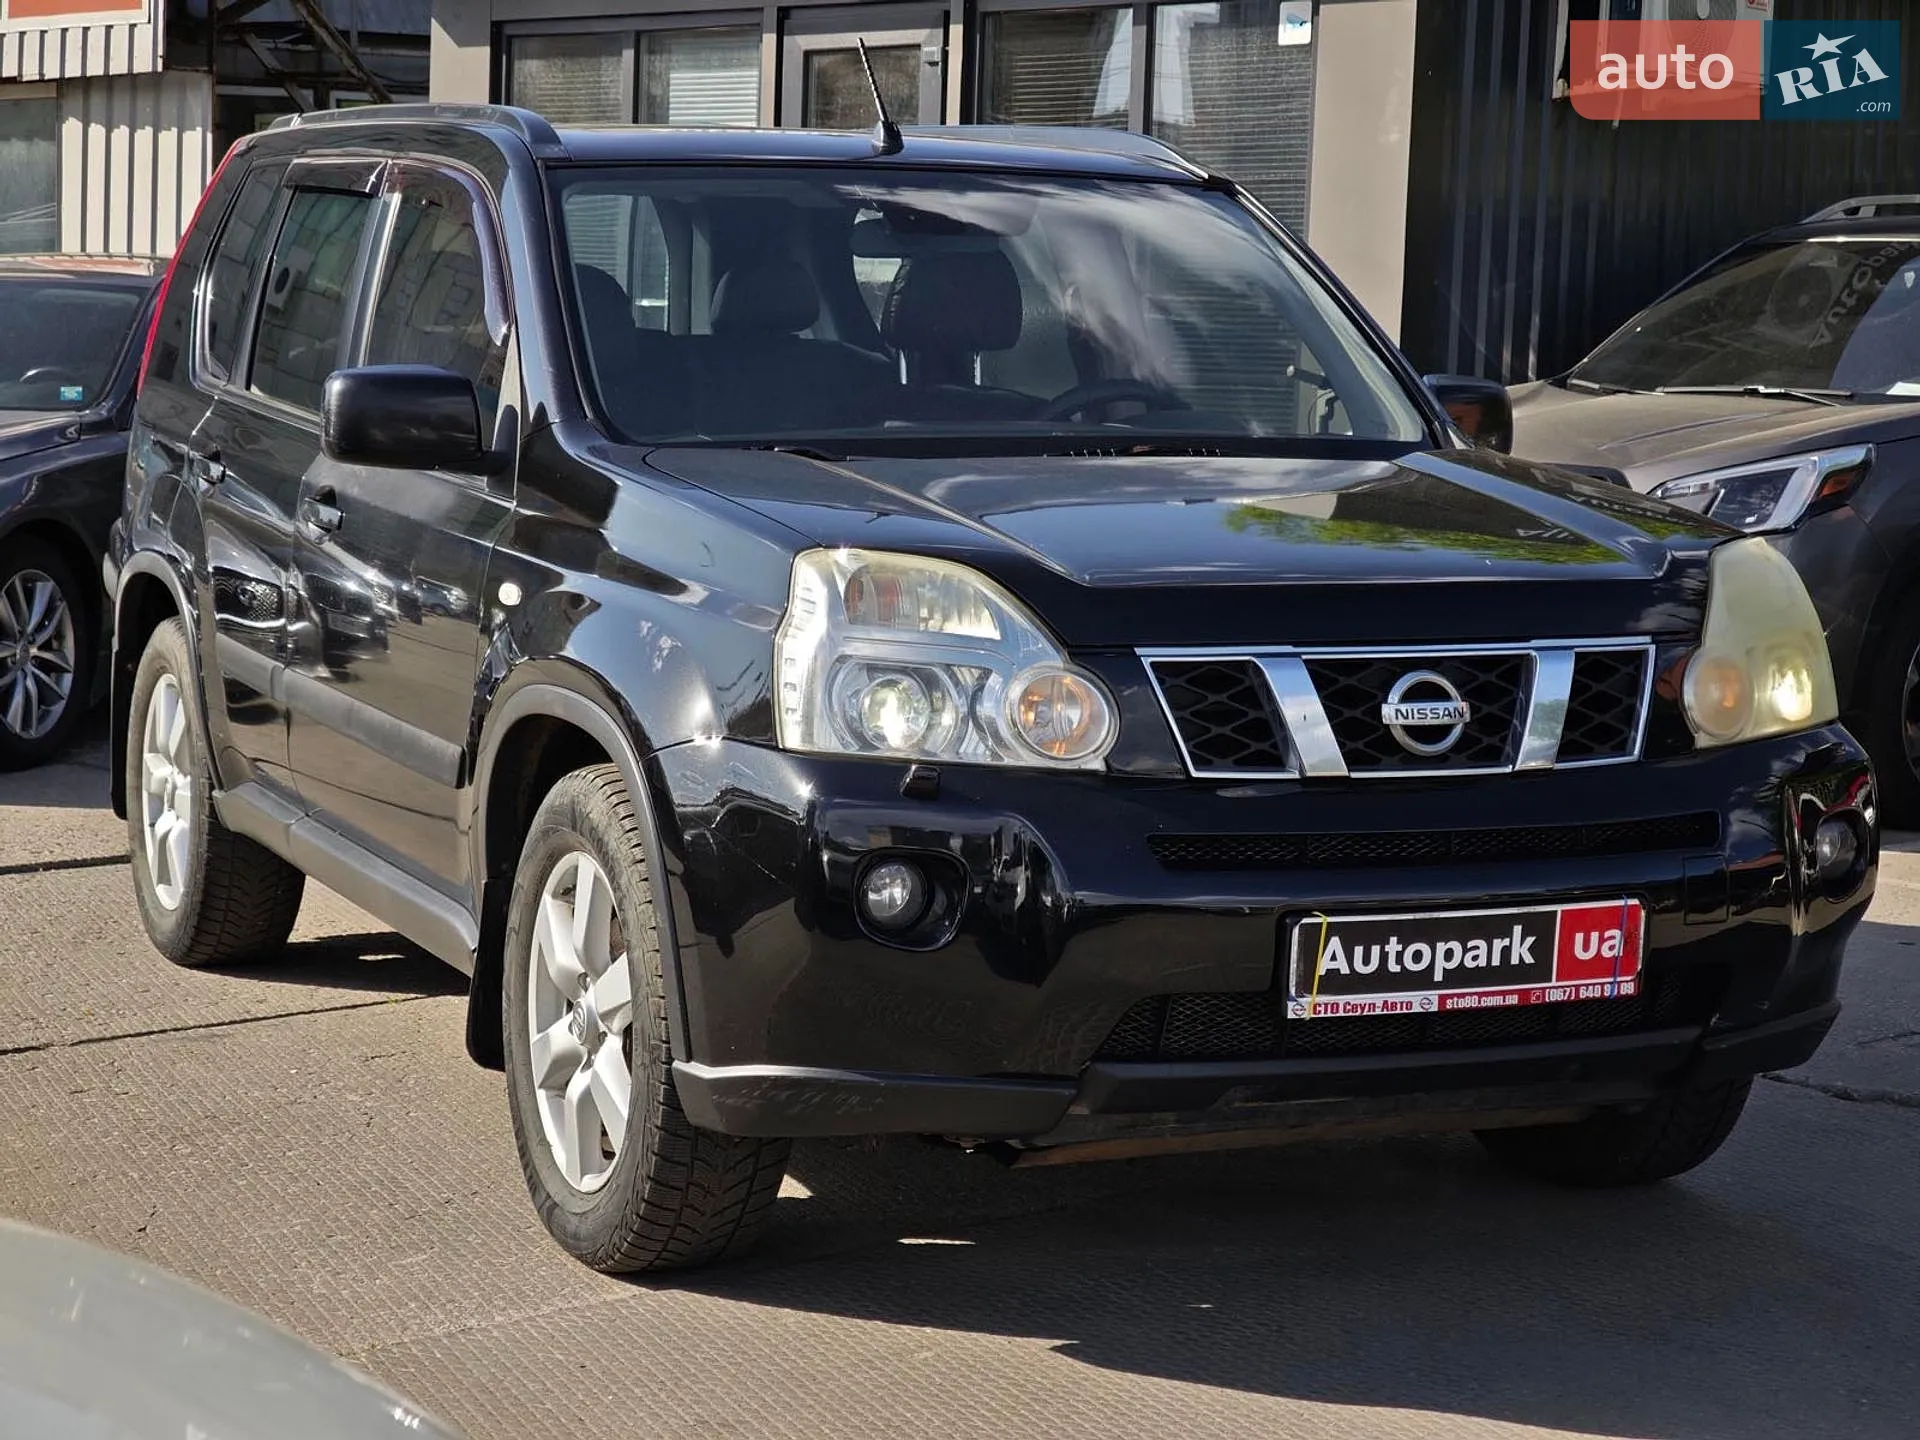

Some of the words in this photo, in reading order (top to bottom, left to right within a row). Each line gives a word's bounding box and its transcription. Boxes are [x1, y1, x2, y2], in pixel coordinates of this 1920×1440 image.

[1395, 706, 1464, 721] NISSAN
[1318, 924, 1537, 982] Autopark
[1574, 928, 1625, 961] ua
